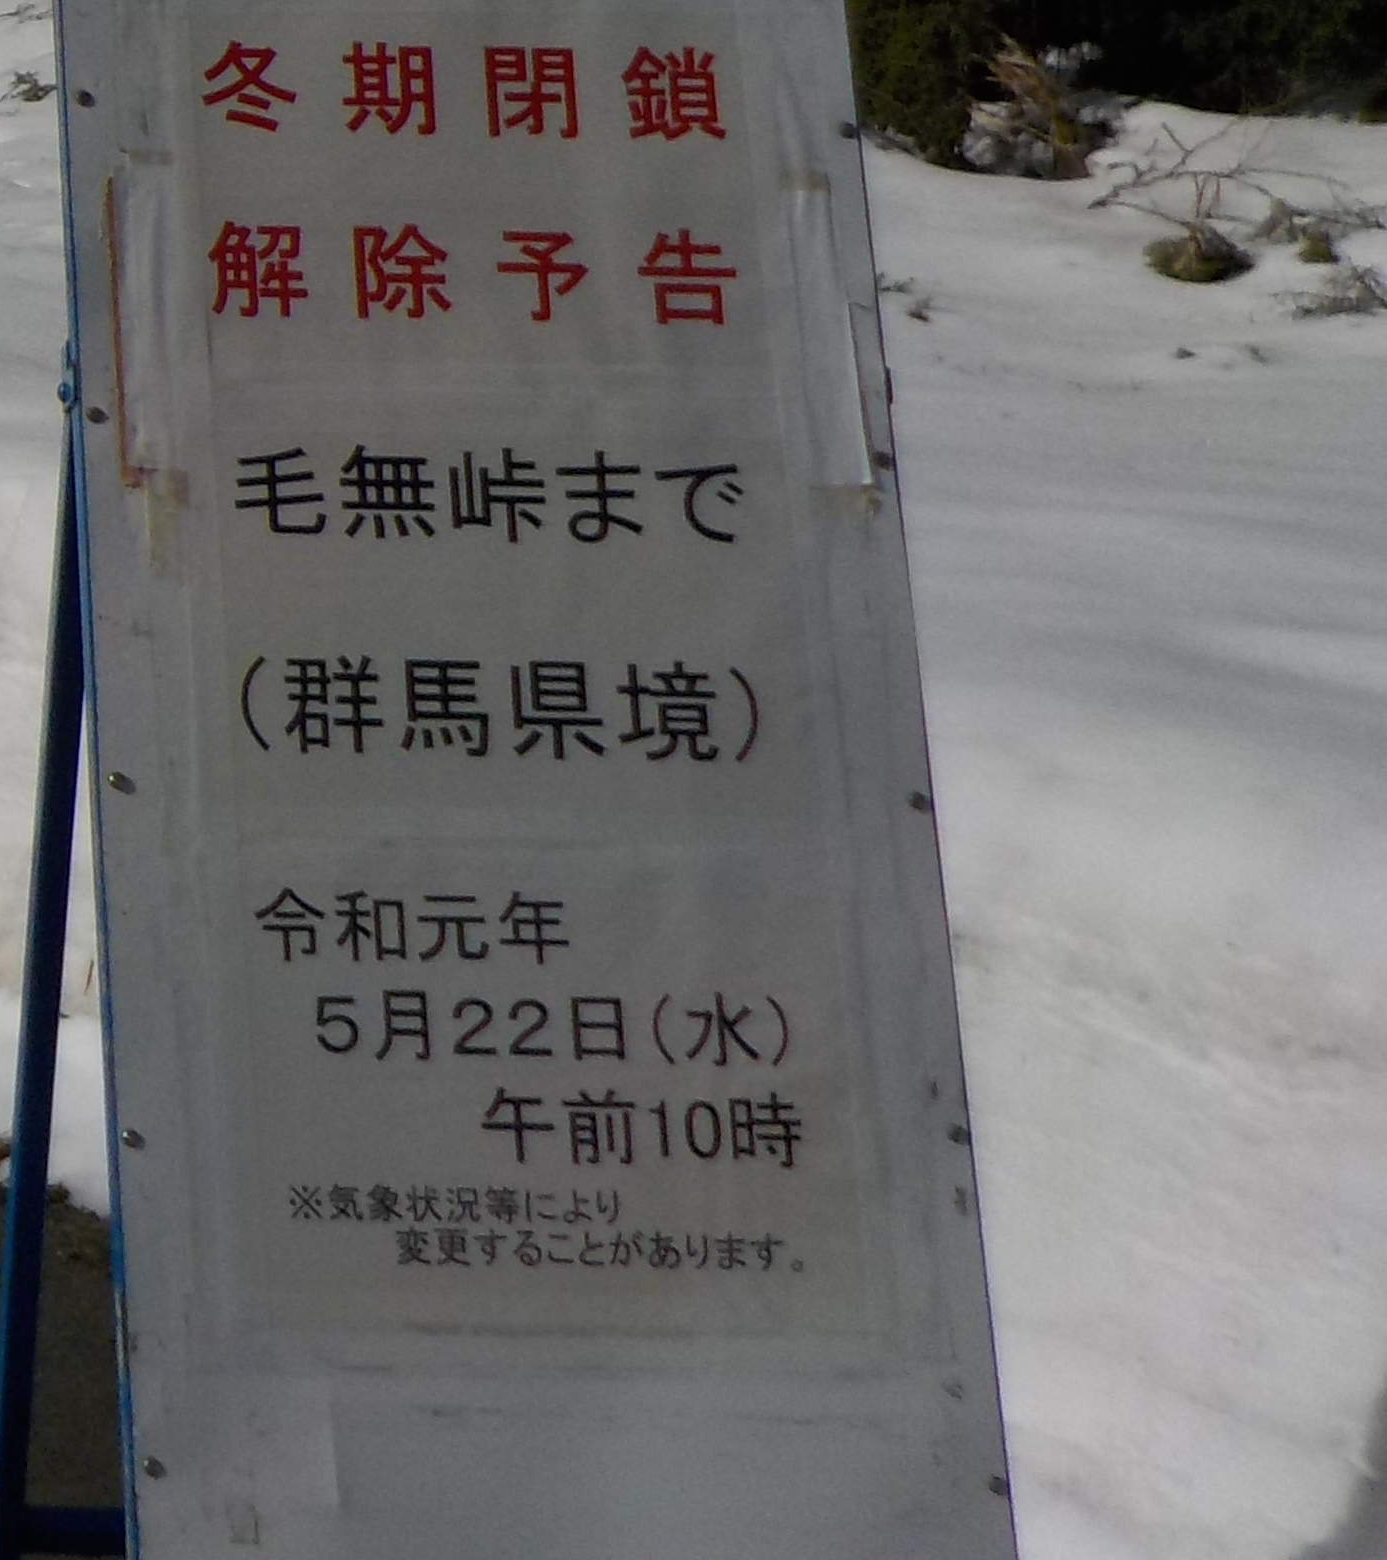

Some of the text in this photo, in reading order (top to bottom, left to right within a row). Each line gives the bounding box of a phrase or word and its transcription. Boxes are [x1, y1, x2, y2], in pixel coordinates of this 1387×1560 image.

[201, 40, 727, 141] 冬期閉鎖
[208, 220, 737, 326] 解除予告
[235, 445, 744, 544] 毛無峠まで
[241, 655, 759, 763] （群馬県境）
[254, 887, 569, 965] 令和元年
[316, 989, 789, 1067] 5月22日（水）
[481, 1087, 802, 1169] 午前10時
[289, 1184, 622, 1225] ※気象状況等により
[395, 1227, 804, 1273] 変更することがあります。
